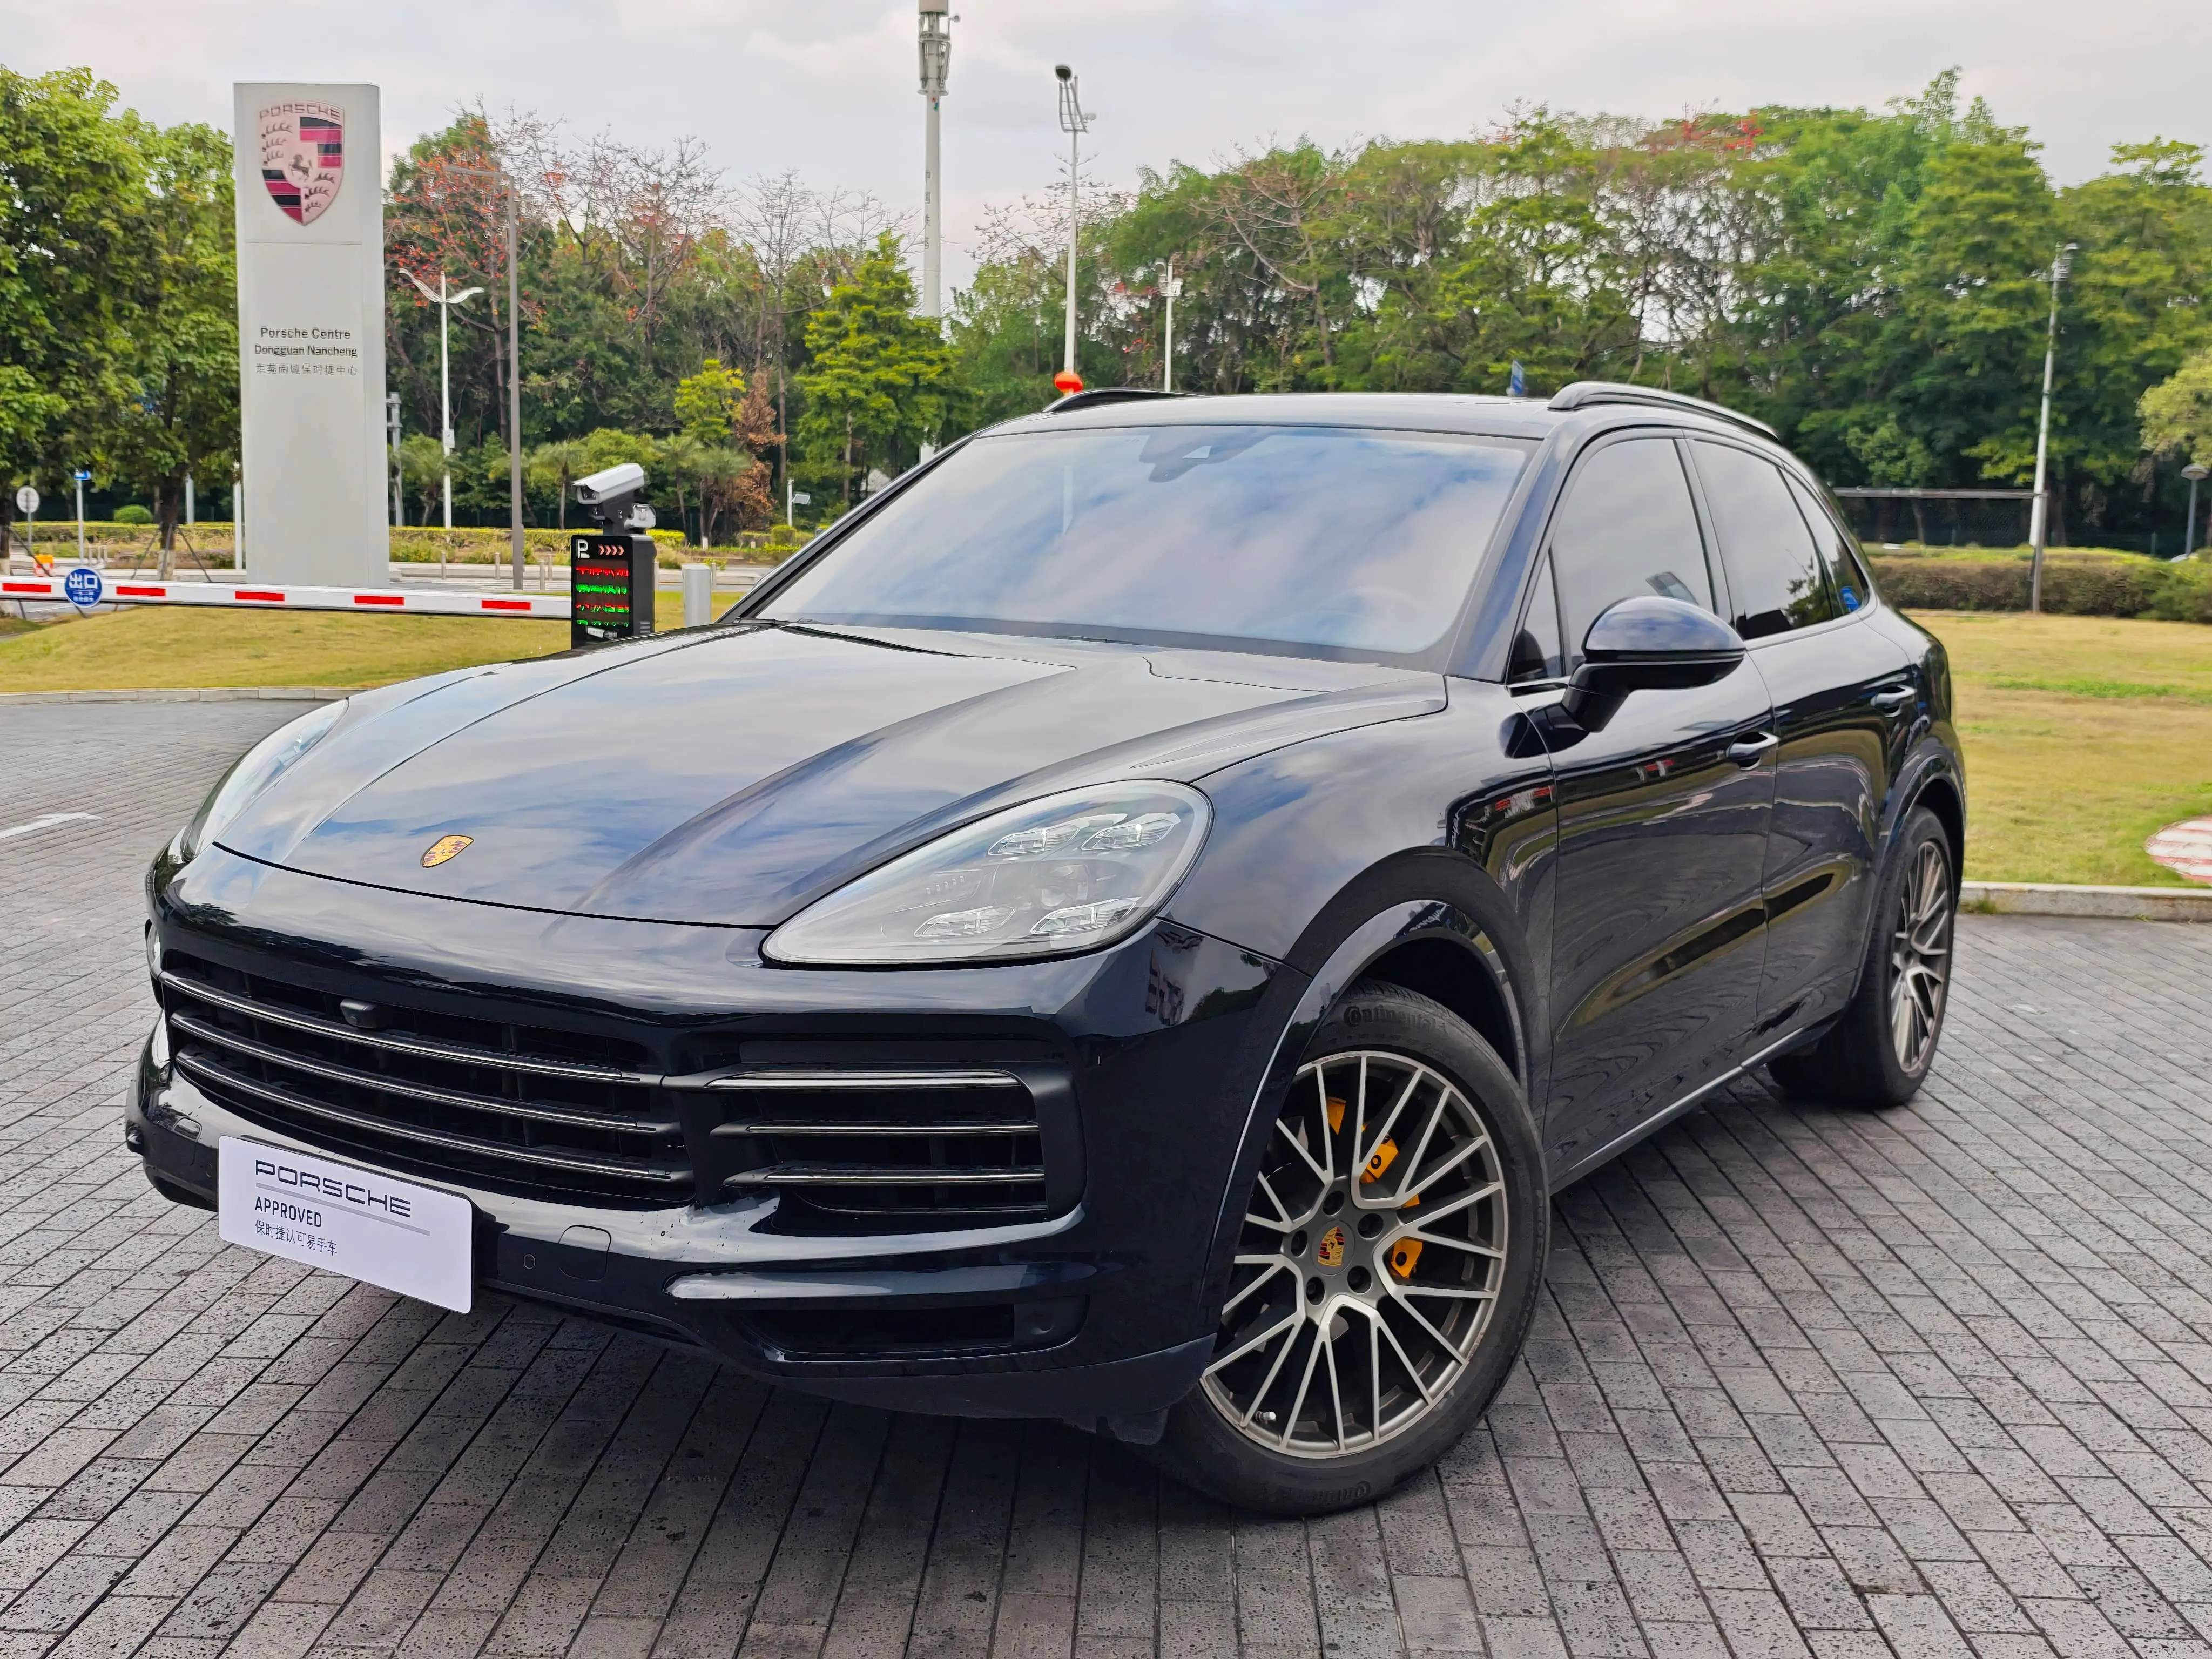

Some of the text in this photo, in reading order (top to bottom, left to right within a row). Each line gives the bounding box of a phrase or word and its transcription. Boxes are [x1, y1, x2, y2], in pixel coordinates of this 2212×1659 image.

[260, 103, 341, 121] PORSCHE
[261, 327, 350, 340] Porsche Centre
[254, 345, 358, 359] Dongguan Nancheng
[69, 573, 98, 589] 出口
[255, 1159, 411, 1218] PORSCHE
[255, 1196, 322, 1228] APPROVED
[255, 1219, 338, 1257] 保时捷认可易手车
